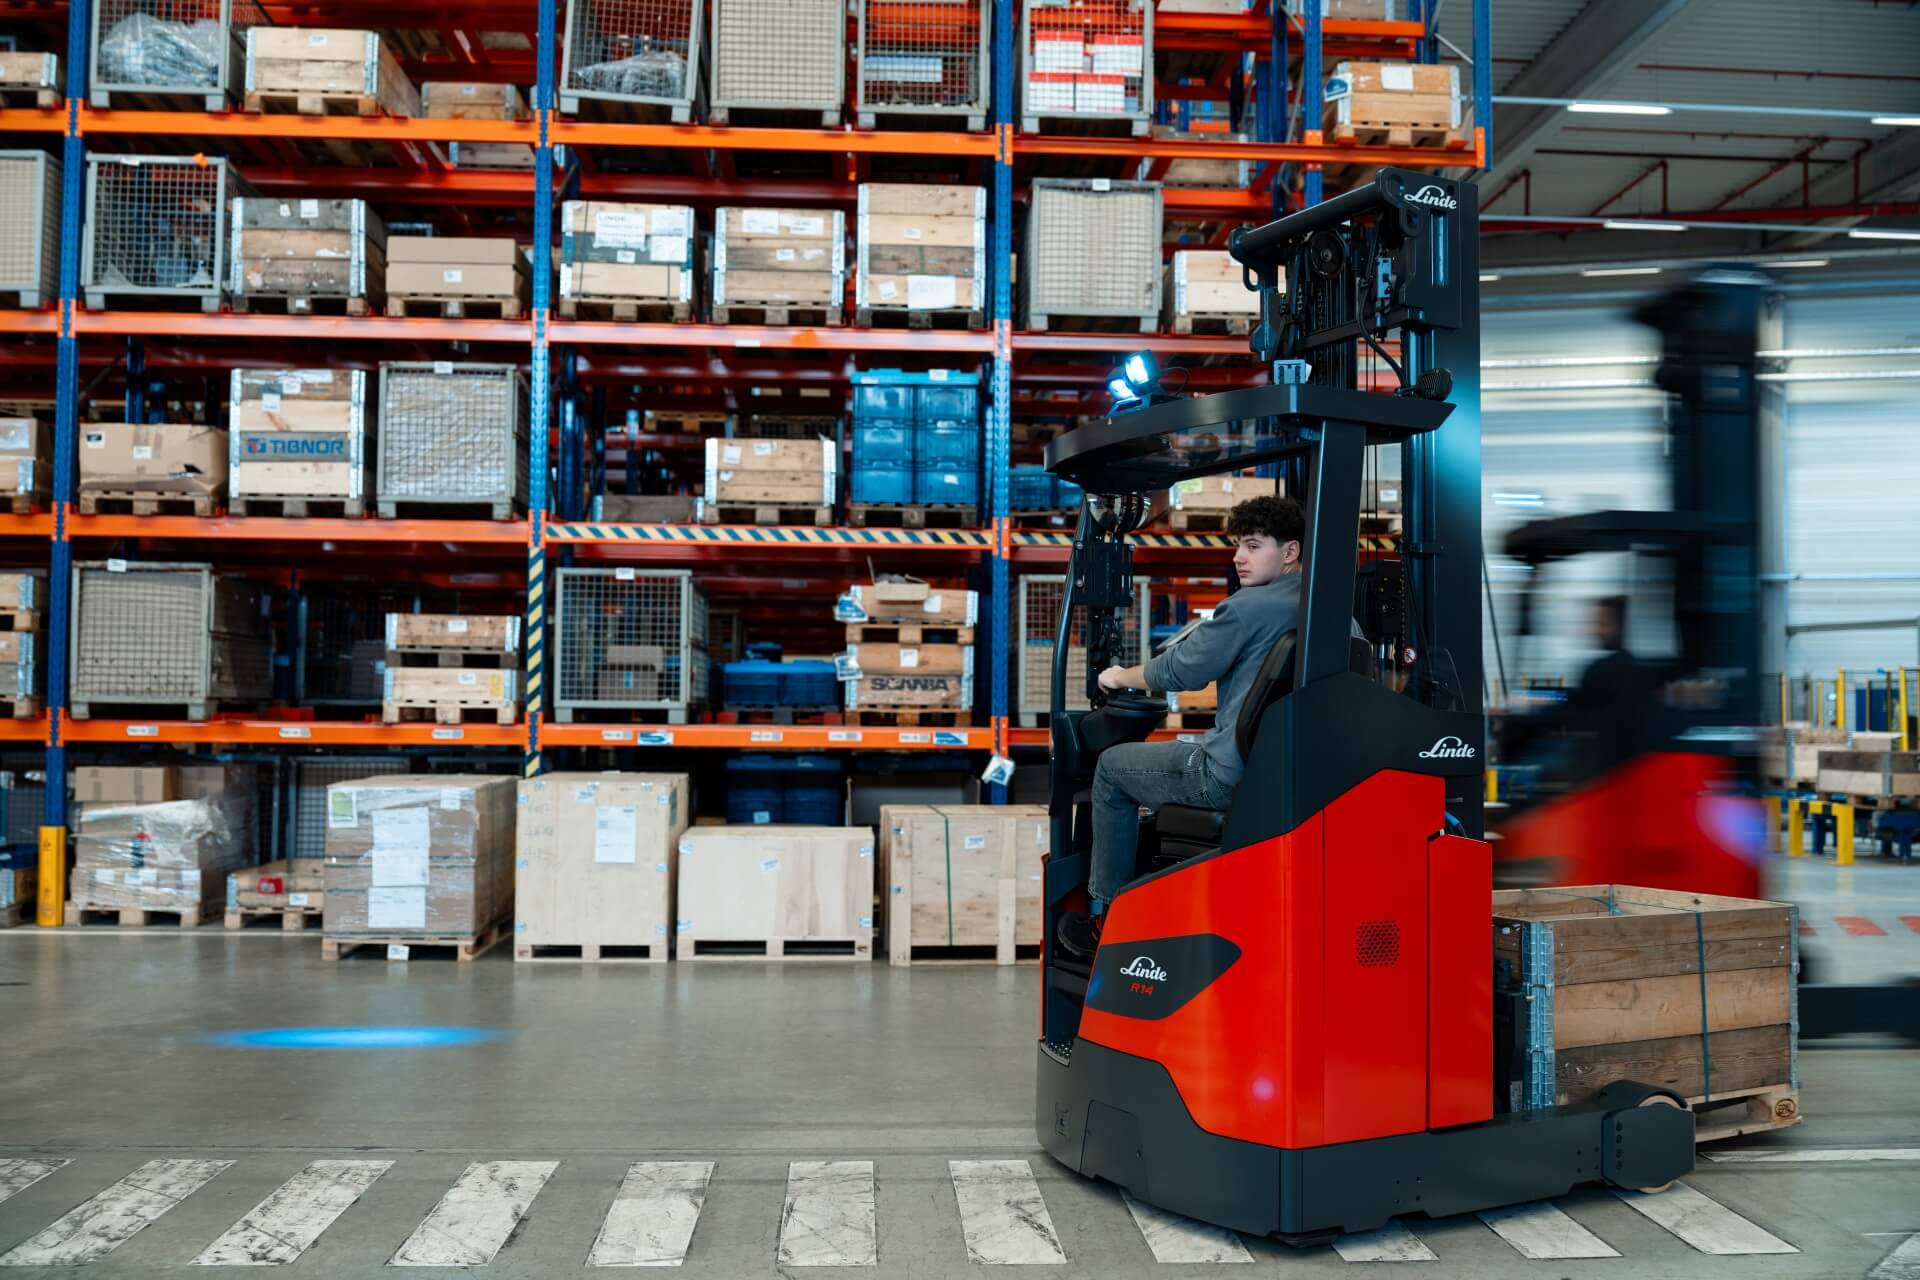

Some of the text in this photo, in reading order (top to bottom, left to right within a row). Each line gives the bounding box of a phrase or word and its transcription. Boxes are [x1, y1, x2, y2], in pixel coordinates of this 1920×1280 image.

[1404, 185, 1457, 210] Linde
[270, 439, 344, 454] TIBNOR
[870, 678, 949, 691] SCANIA
[1418, 736, 1476, 759] Linde
[1119, 956, 1168, 982] Linde
